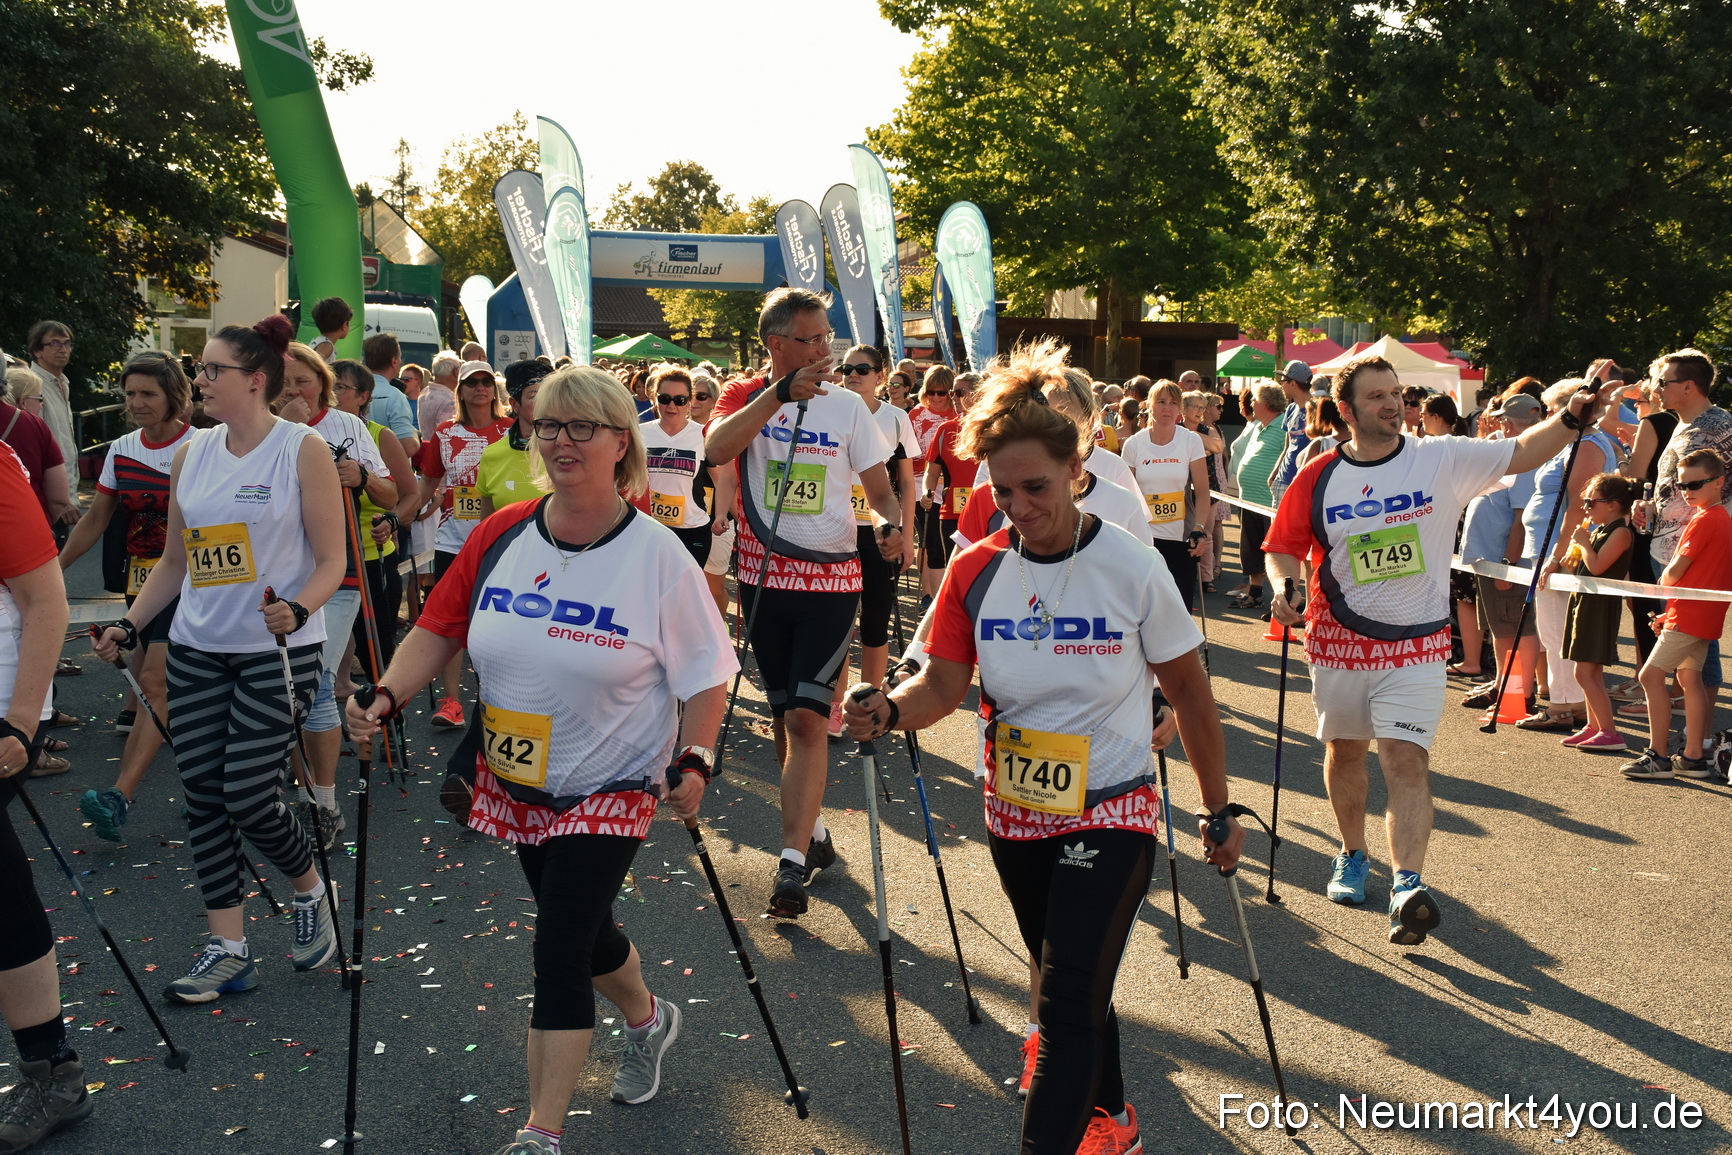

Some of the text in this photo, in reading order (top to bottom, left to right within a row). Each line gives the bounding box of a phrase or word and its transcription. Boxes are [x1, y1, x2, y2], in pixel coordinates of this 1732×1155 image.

[658, 261, 723, 275] firmenlauf
[772, 478, 817, 500] 1743
[651, 502, 679, 517] 1620
[1155, 503, 1177, 515] 880
[1385, 503, 1433, 524] energie
[192, 545, 241, 570] 1416
[1360, 544, 1413, 569] 1749
[766, 574, 807, 590] AVIA
[810, 576, 849, 591] AVIA
[547, 626, 626, 650] energie
[1054, 637, 1123, 655] energie
[1326, 642, 1364, 659] AVIA
[1370, 640, 1416, 659] AVIA
[1394, 721, 1427, 735] saller
[485, 727, 534, 765] 742
[498, 759, 516, 770] Silvia
[1004, 754, 1071, 792] 1740
[1012, 784, 1057, 800] Sattler Nicole
[472, 792, 519, 827] AVIA
[1091, 793, 1147, 819] AVIA
[1059, 858, 1094, 869] adidas
